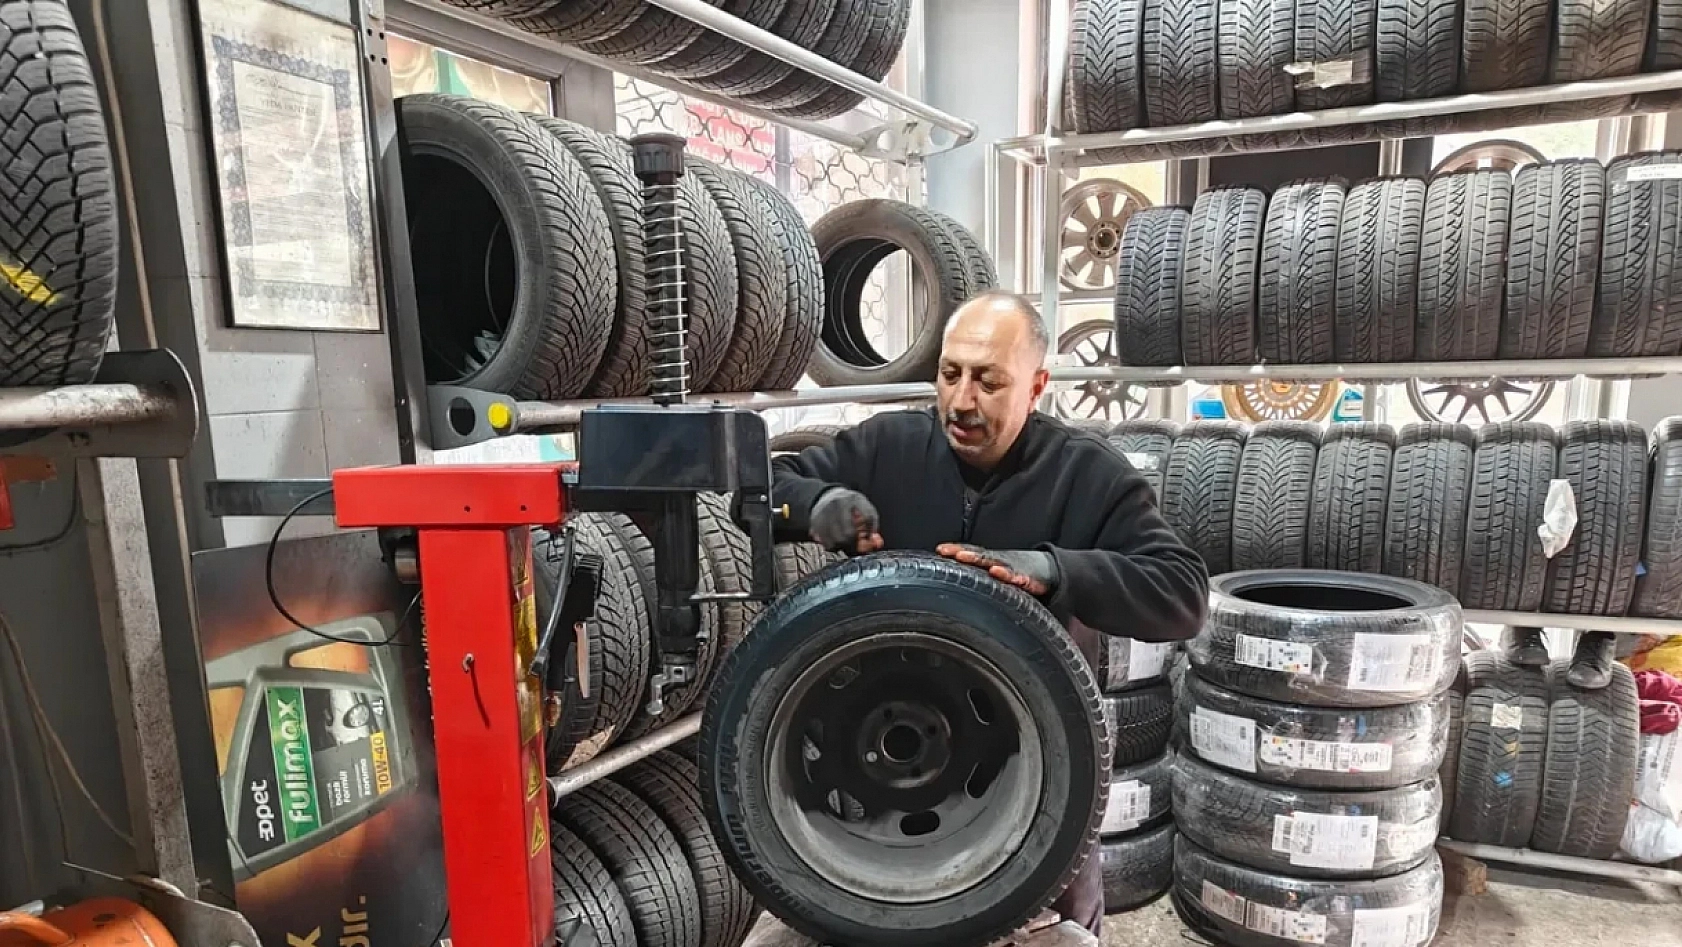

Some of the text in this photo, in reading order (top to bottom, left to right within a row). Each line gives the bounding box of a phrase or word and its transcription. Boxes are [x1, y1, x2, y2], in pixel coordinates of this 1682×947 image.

[373, 699, 385, 715] 4L
[277, 698, 314, 822] fullmax
[373, 736, 390, 790] 10W-40
[251, 778, 275, 842] opet
